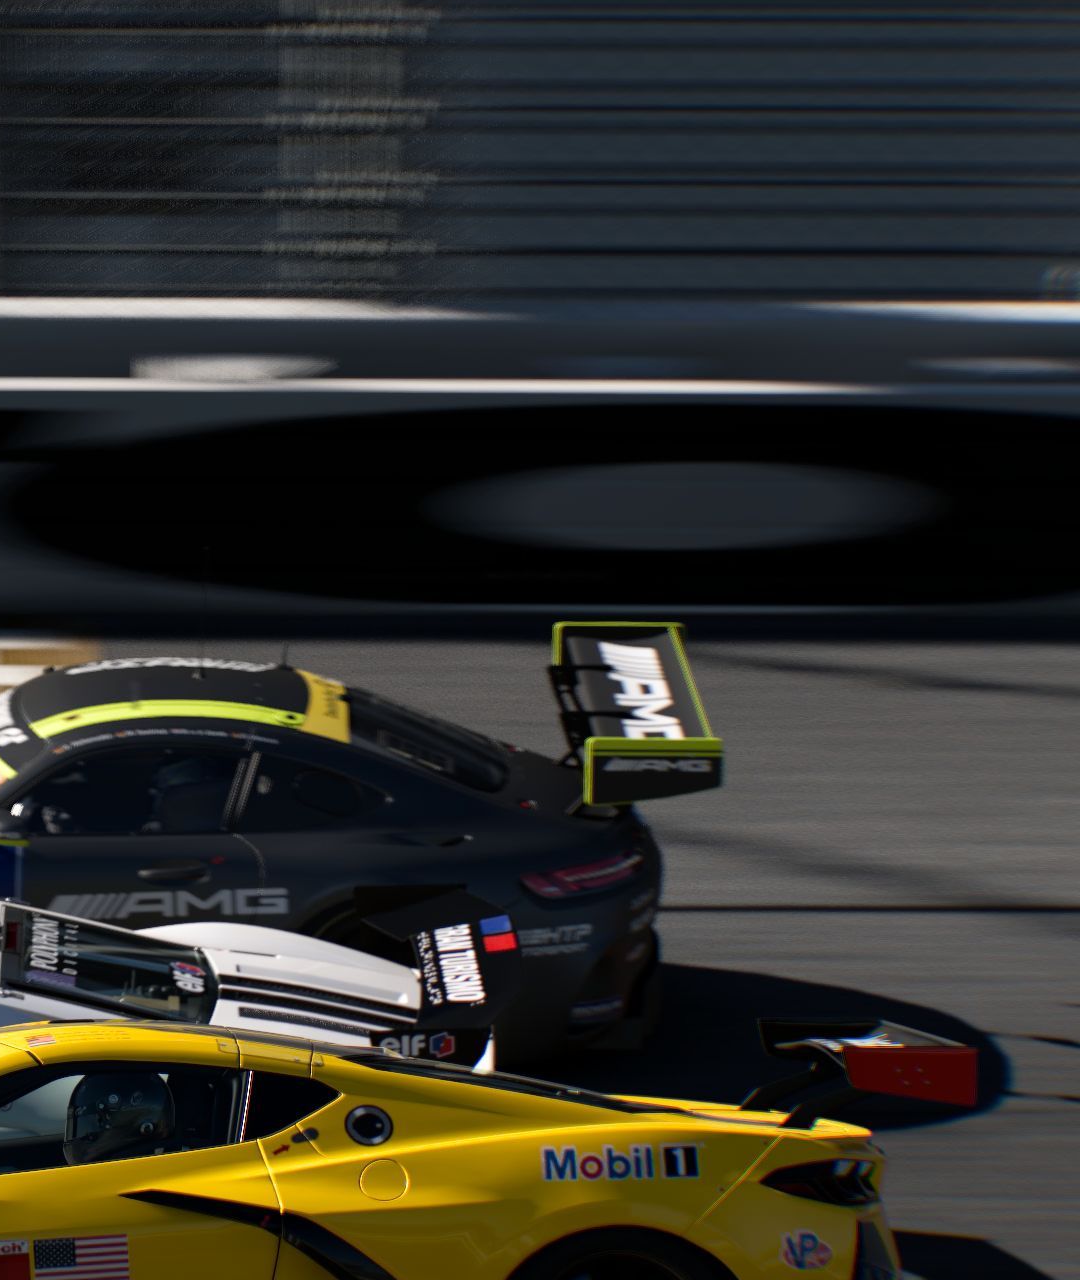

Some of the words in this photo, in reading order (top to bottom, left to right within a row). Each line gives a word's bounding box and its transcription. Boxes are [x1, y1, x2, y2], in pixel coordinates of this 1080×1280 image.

[121, 887, 290, 917] AMG
[173, 969, 206, 994] elf
[439, 949, 487, 1003] TURISMO
[380, 1034, 427, 1057] elf
[543, 1146, 655, 1180] Mobil
